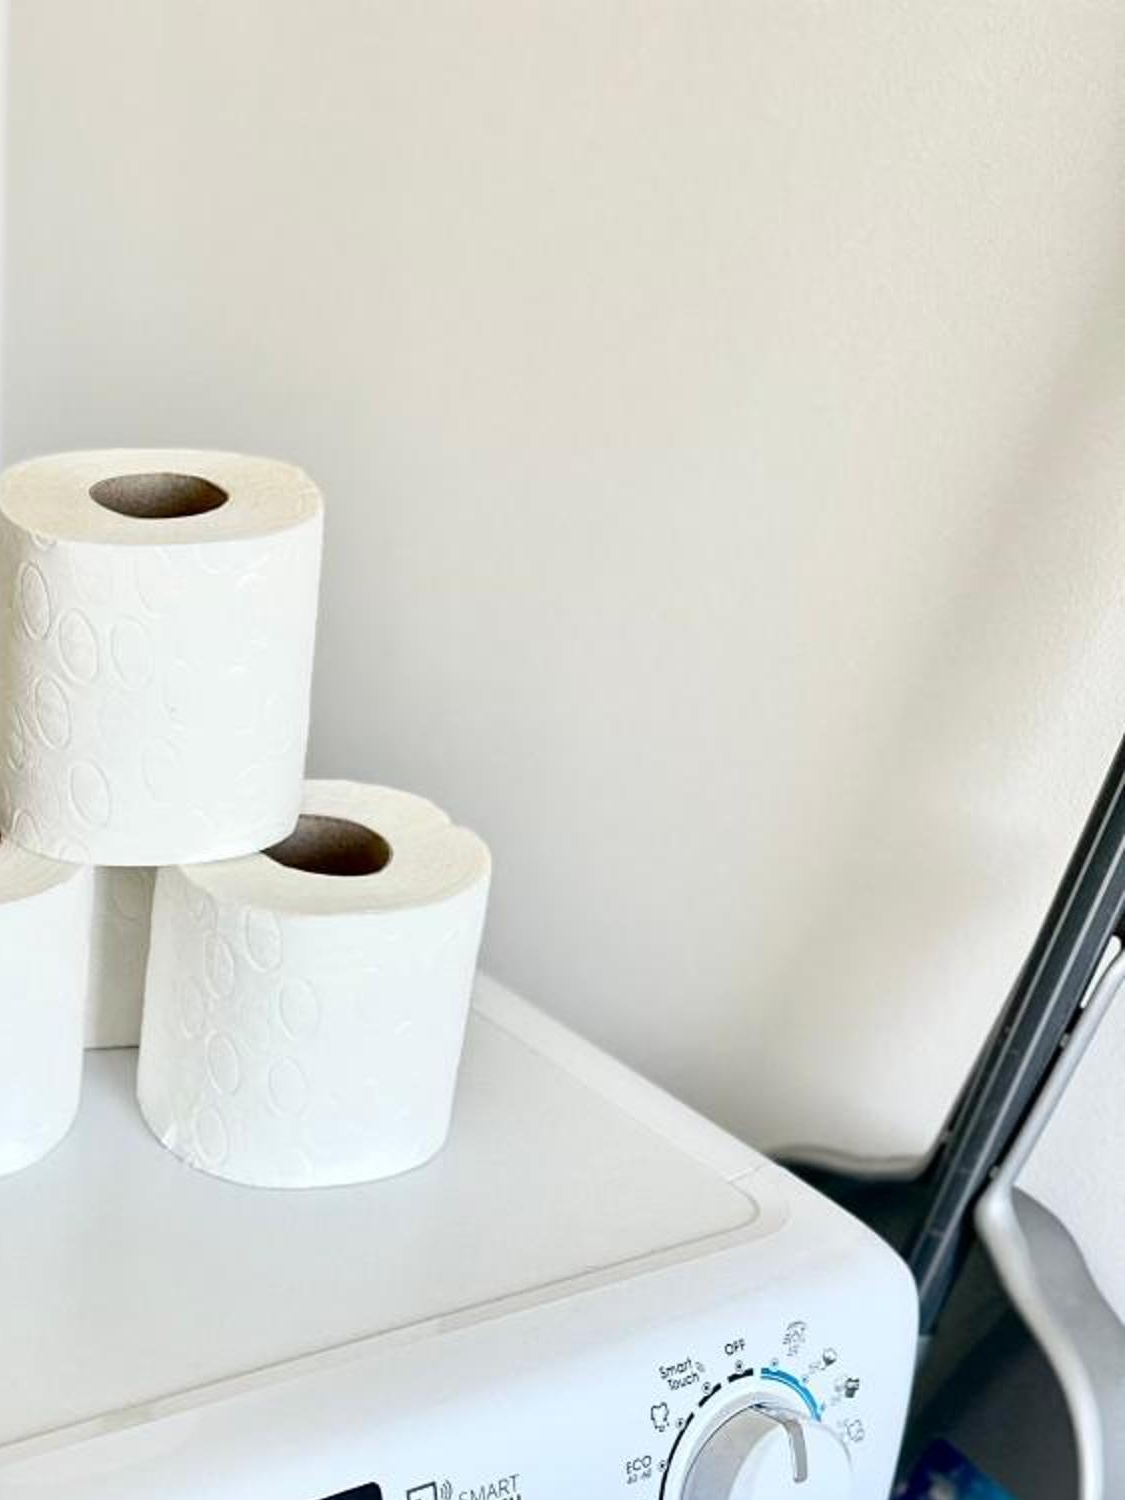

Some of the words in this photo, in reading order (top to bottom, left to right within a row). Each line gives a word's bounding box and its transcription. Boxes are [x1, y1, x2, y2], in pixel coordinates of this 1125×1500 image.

[723, 1337, 746, 1356] OFF
[658, 1356, 693, 1380] Smart
[666, 1371, 701, 1391] Touch
[626, 1455, 653, 1475] ECO
